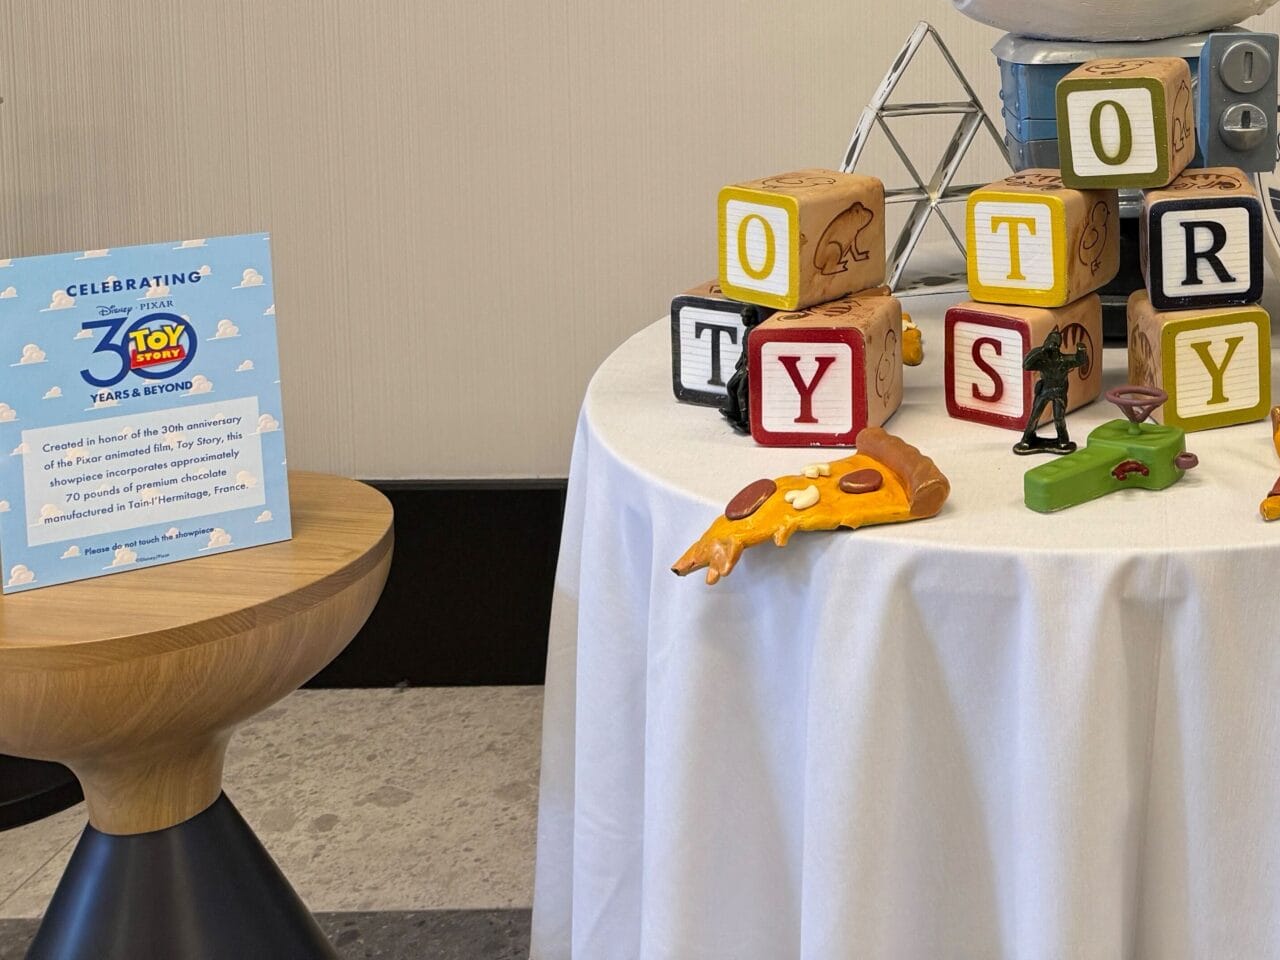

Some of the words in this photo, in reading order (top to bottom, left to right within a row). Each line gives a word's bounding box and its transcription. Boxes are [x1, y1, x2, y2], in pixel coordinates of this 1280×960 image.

[1089, 100, 1133, 166] O
[990, 215, 1036, 281] T
[1179, 220, 1237, 287] R
[66, 271, 202, 297] CELEBRATING
[96, 304, 133, 316] Disney
[140, 300, 174, 311] PIXAR
[136, 348, 181, 362] STORY
[695, 321, 738, 387] T
[971, 336, 1004, 403] S
[1190, 336, 1244, 406] Y
[90, 389, 130, 403] YEARS
[131, 388, 142, 398] &
[143, 380, 193, 396] BEYOND
[778, 356, 837, 424] Y
[42, 438, 84, 453] Created
[86, 437, 95, 446] in
[98, 434, 128, 444] honor
[131, 429, 141, 439] of
[143, 428, 158, 437] the
[161, 423, 184, 434] 30th
[186, 416, 242, 431] anniversary
[44, 460, 54, 471] of
[57, 458, 73, 468] the
[76, 455, 102, 465] Pixar
[104, 445, 151, 461] animated
[153, 443, 174, 453] film,
[176, 440, 194, 450] Toy
[196, 436, 224, 446] Story,
[227, 431, 243, 441] this
[49, 473, 103, 488] showpiece
[106, 462, 168, 478] incorporates
[170, 449, 240, 468] approximately
[66, 492, 80, 503] 70
[83, 485, 120, 502] pounds
[123, 482, 133, 493] of
[136, 478, 178, 493] premium
[181, 468, 227, 483] chocolate
[44, 504, 114, 525] manufactured
[116, 502, 126, 511] in
[214, 483, 249, 495] France.
[84, 546, 110, 556] Please
[112, 542, 122, 551] do
[124, 540, 137, 548] not
[139, 535, 159, 545] touch
[161, 532, 173, 541] the
